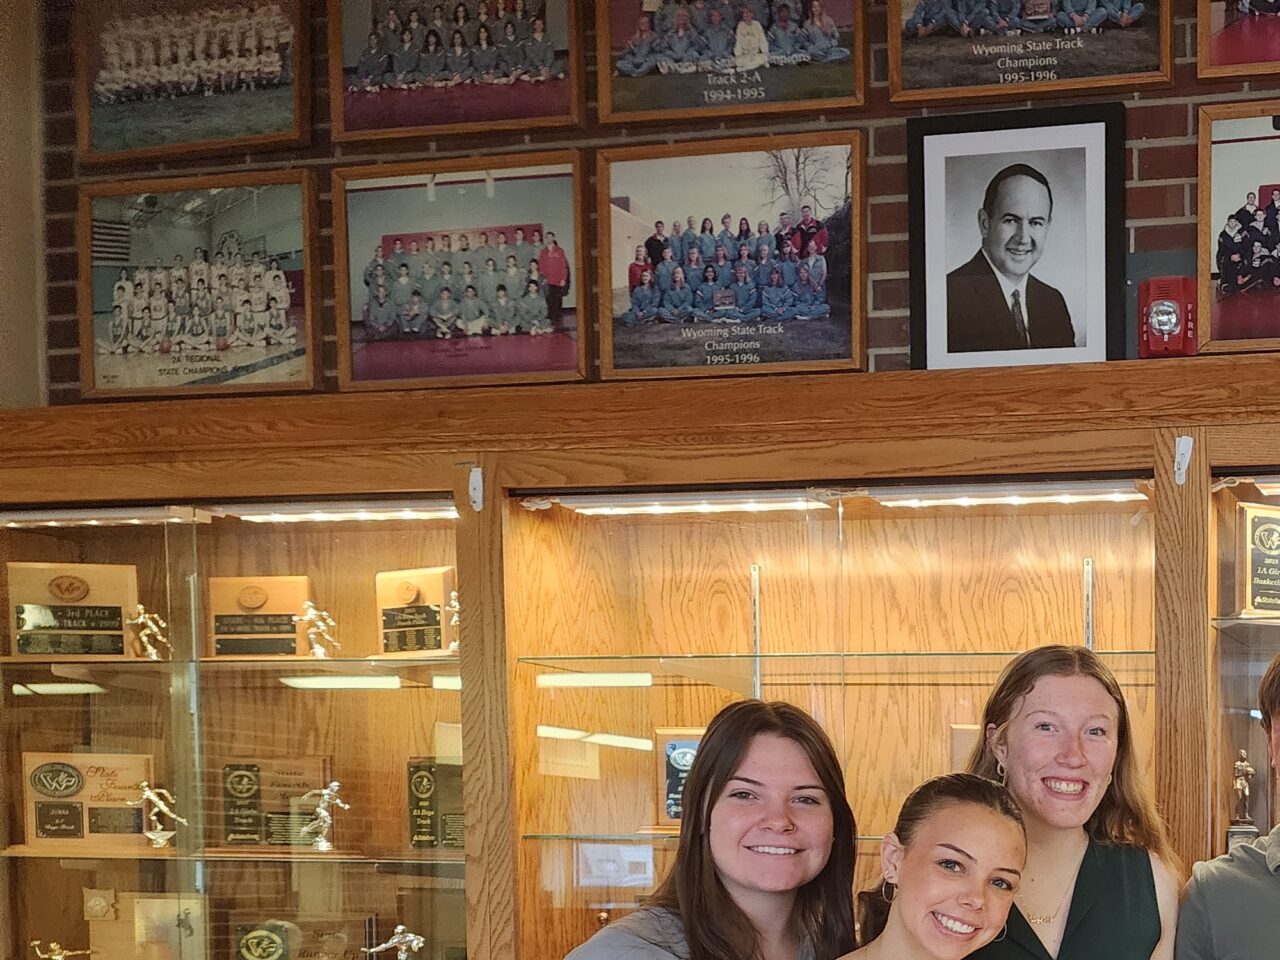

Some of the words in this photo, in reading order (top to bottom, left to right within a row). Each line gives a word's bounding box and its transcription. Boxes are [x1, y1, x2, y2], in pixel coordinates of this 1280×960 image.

[972, 42, 1023, 56] Wyoming
[1026, 41, 1053, 52] State
[1055, 37, 1084, 49] Track
[997, 55, 1058, 69] Champions
[707, 73, 736, 84] Track
[999, 70, 1057, 83] 1995-1996
[703, 88, 766, 102] 1994-1995
[1187, 303, 1195, 338] FIRE
[681, 326, 729, 339] Wyoming
[731, 324, 756, 336] State
[758, 322, 784, 334] Track
[705, 339, 761, 351] Champions
[705, 352, 760, 365] 1995-1996
